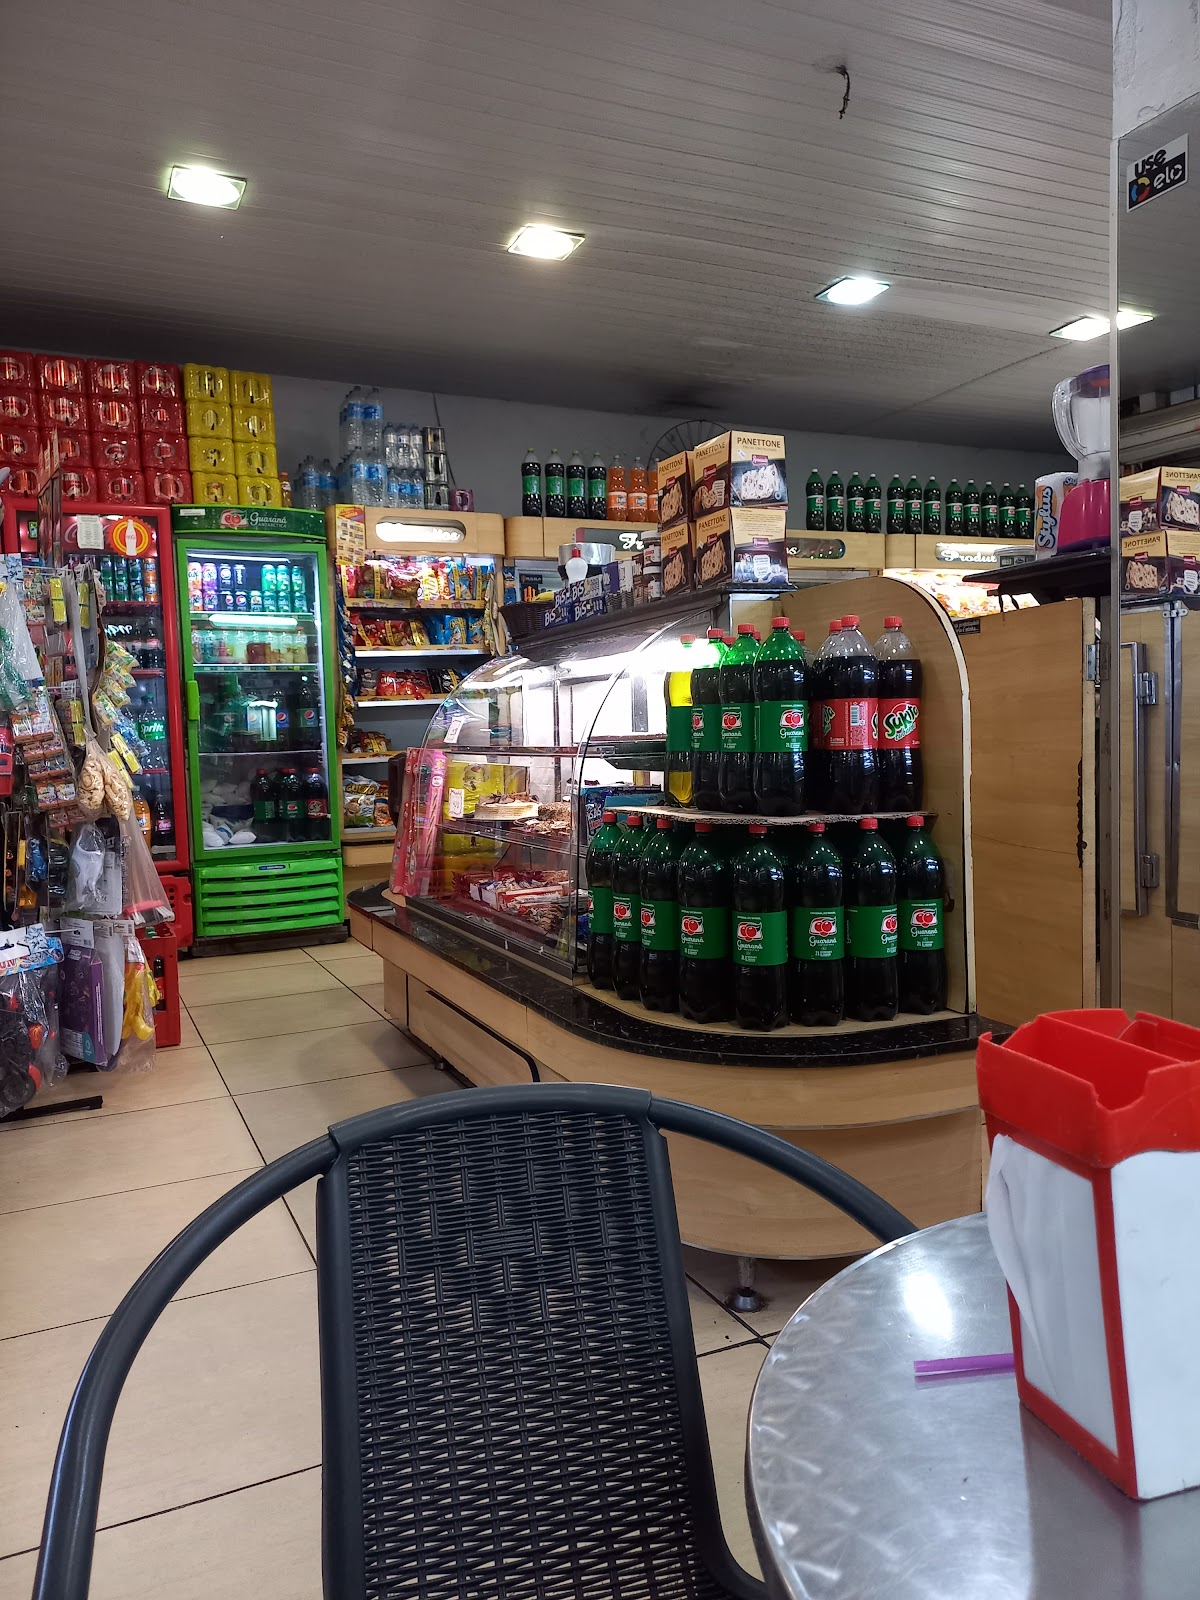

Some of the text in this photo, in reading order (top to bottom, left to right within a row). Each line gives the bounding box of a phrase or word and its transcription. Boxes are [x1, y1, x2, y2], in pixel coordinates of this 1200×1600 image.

[1135, 149, 1167, 178] use
[1153, 164, 1183, 189] elo
[737, 437, 781, 448] PANETTONE
[695, 442, 726, 459] PANETTONE
[659, 458, 684, 474] PANETTONE
[250, 512, 287, 526] Guaraná
[698, 514, 727, 530] PANETTONE
[1037, 485, 1057, 549] Stylus
[661, 528, 685, 543] PANETTONE
[140, 722, 164, 734] Sprite
[780, 728, 804, 739] Guaraná
[681, 932, 705, 944] Guaraná
[910, 926, 938, 938] Guaraná
[736, 940, 763, 951] Guaraná
[809, 935, 837, 947] Guaraná
